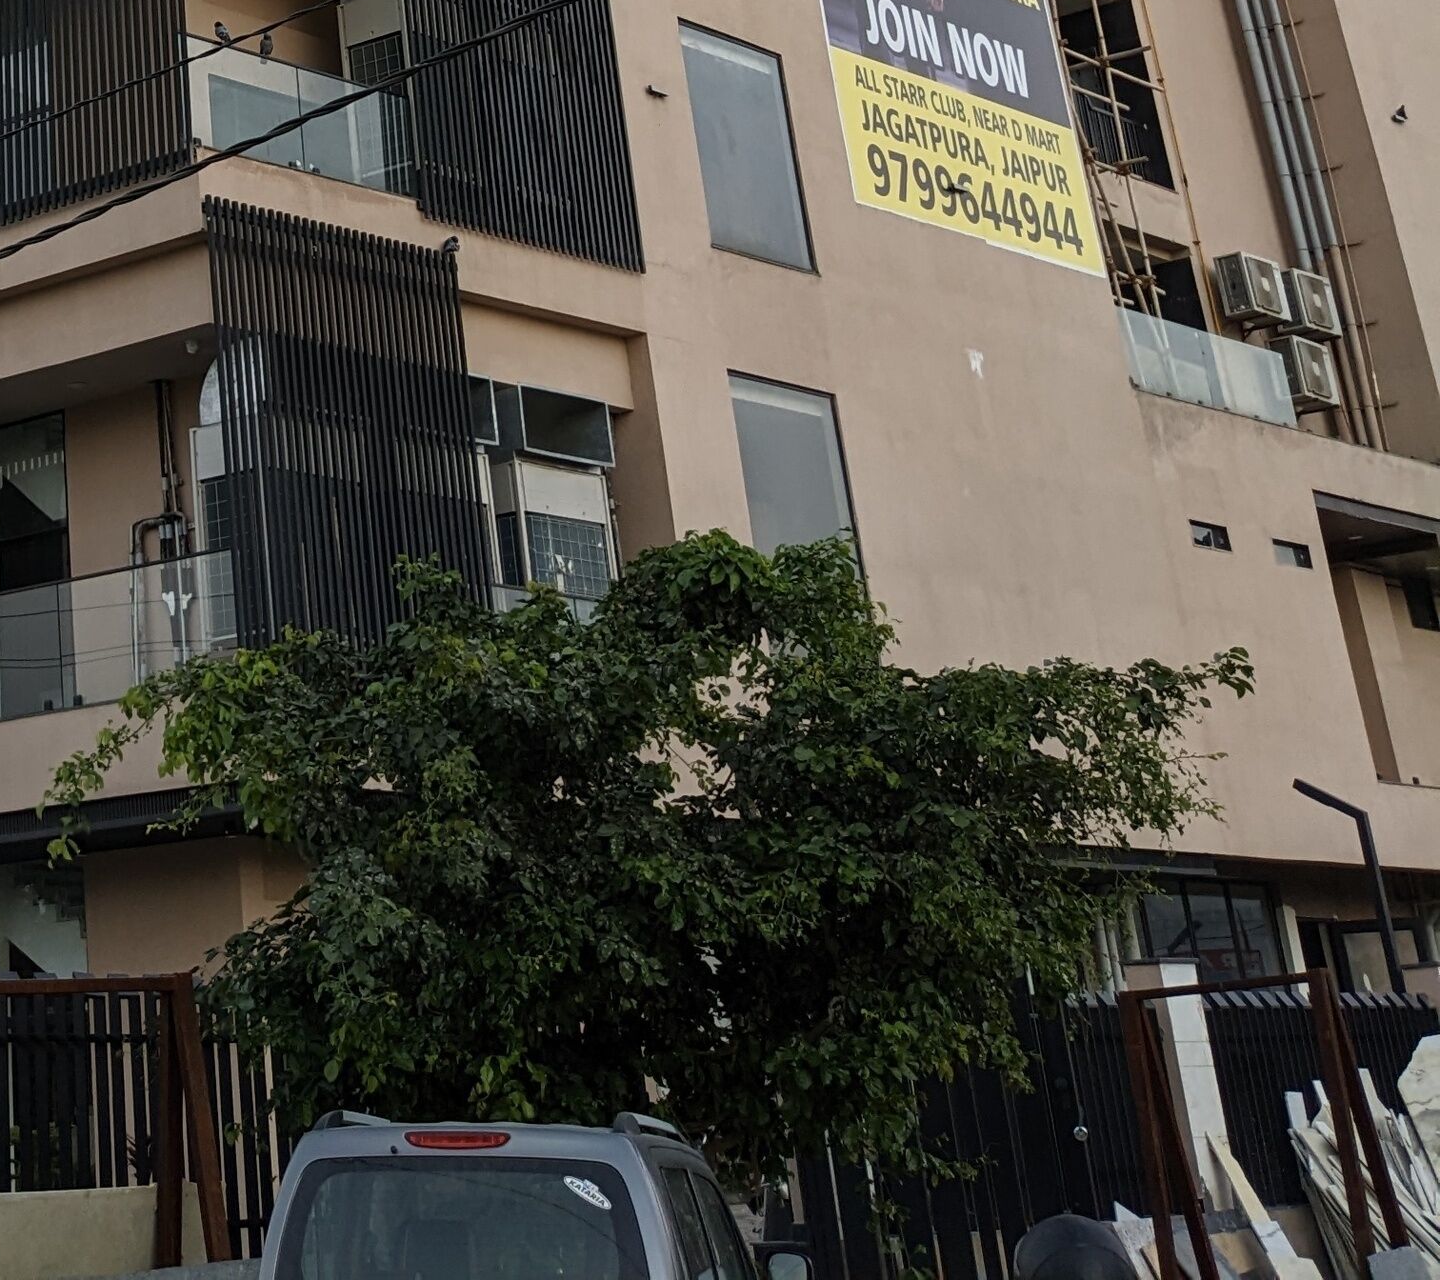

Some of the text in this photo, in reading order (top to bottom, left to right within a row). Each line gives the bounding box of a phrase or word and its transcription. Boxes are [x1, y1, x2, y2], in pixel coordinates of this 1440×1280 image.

[947, 21, 1030, 99] NOW
[855, 64, 1062, 156] ALL STARR CLUB, NEAR D MART
[862, 99, 1072, 197] JAGATPURA, JAIPUR
[867, 144, 1084, 256] 9799644944
[569, 1180, 605, 1206] KATARIA
